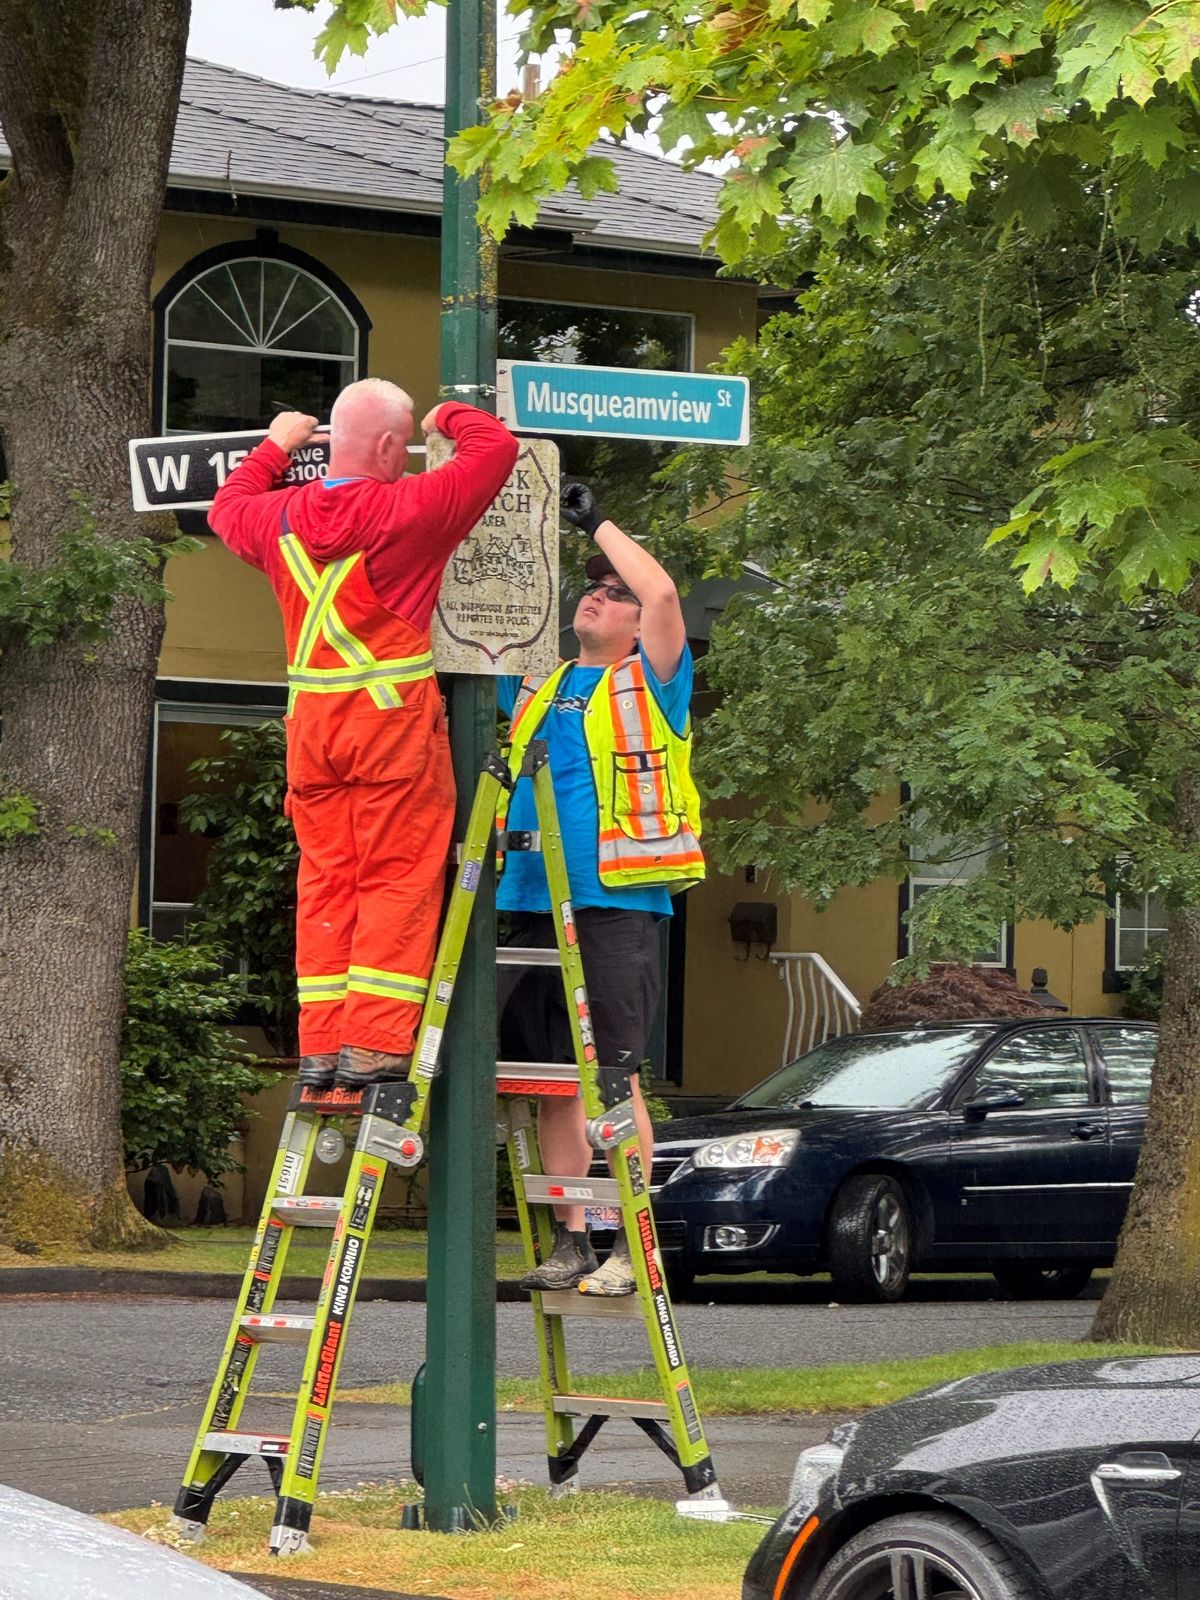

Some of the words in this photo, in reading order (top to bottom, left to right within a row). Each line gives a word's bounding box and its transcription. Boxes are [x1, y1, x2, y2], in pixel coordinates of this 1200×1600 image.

[526, 380, 712, 424] Musqueamview
[717, 388, 732, 408] St
[147, 454, 191, 493] W
[290, 447, 325, 463] Ave
